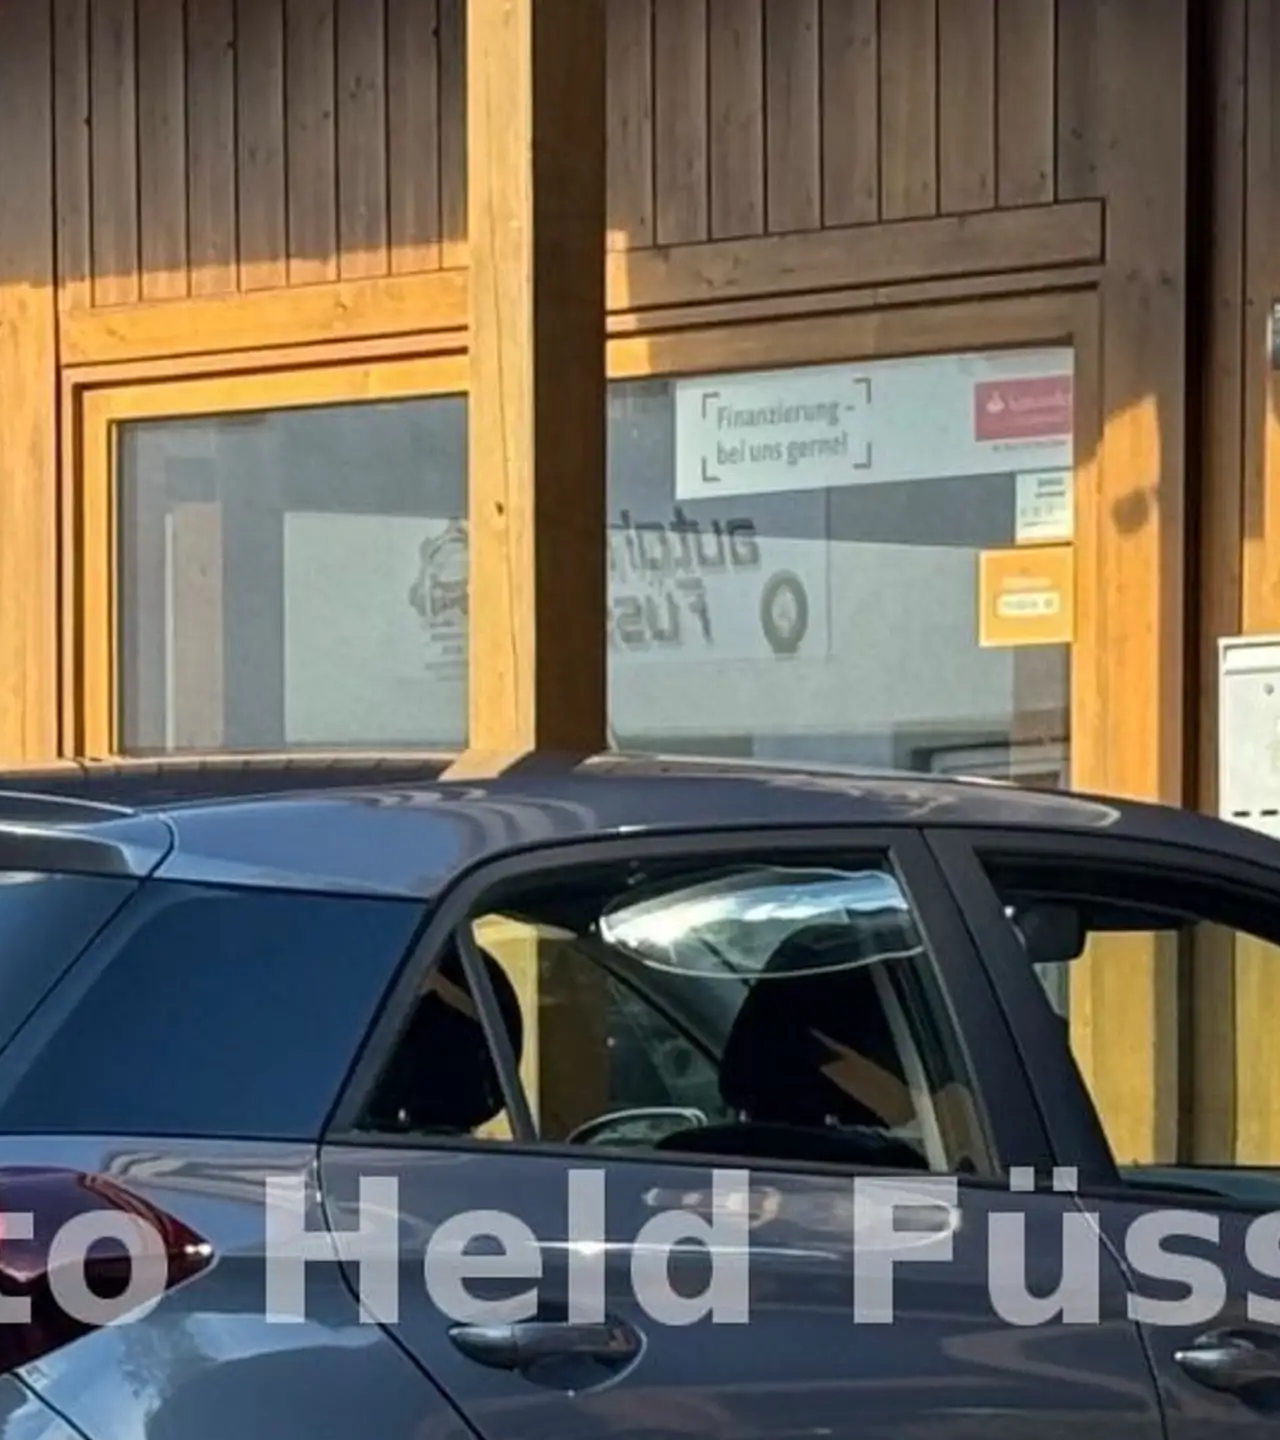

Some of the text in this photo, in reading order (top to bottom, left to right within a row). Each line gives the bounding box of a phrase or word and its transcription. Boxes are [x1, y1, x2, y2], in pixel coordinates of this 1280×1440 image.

[716, 401, 841, 430] Finanzierung
[716, 429, 850, 466] bei uns gerne!
